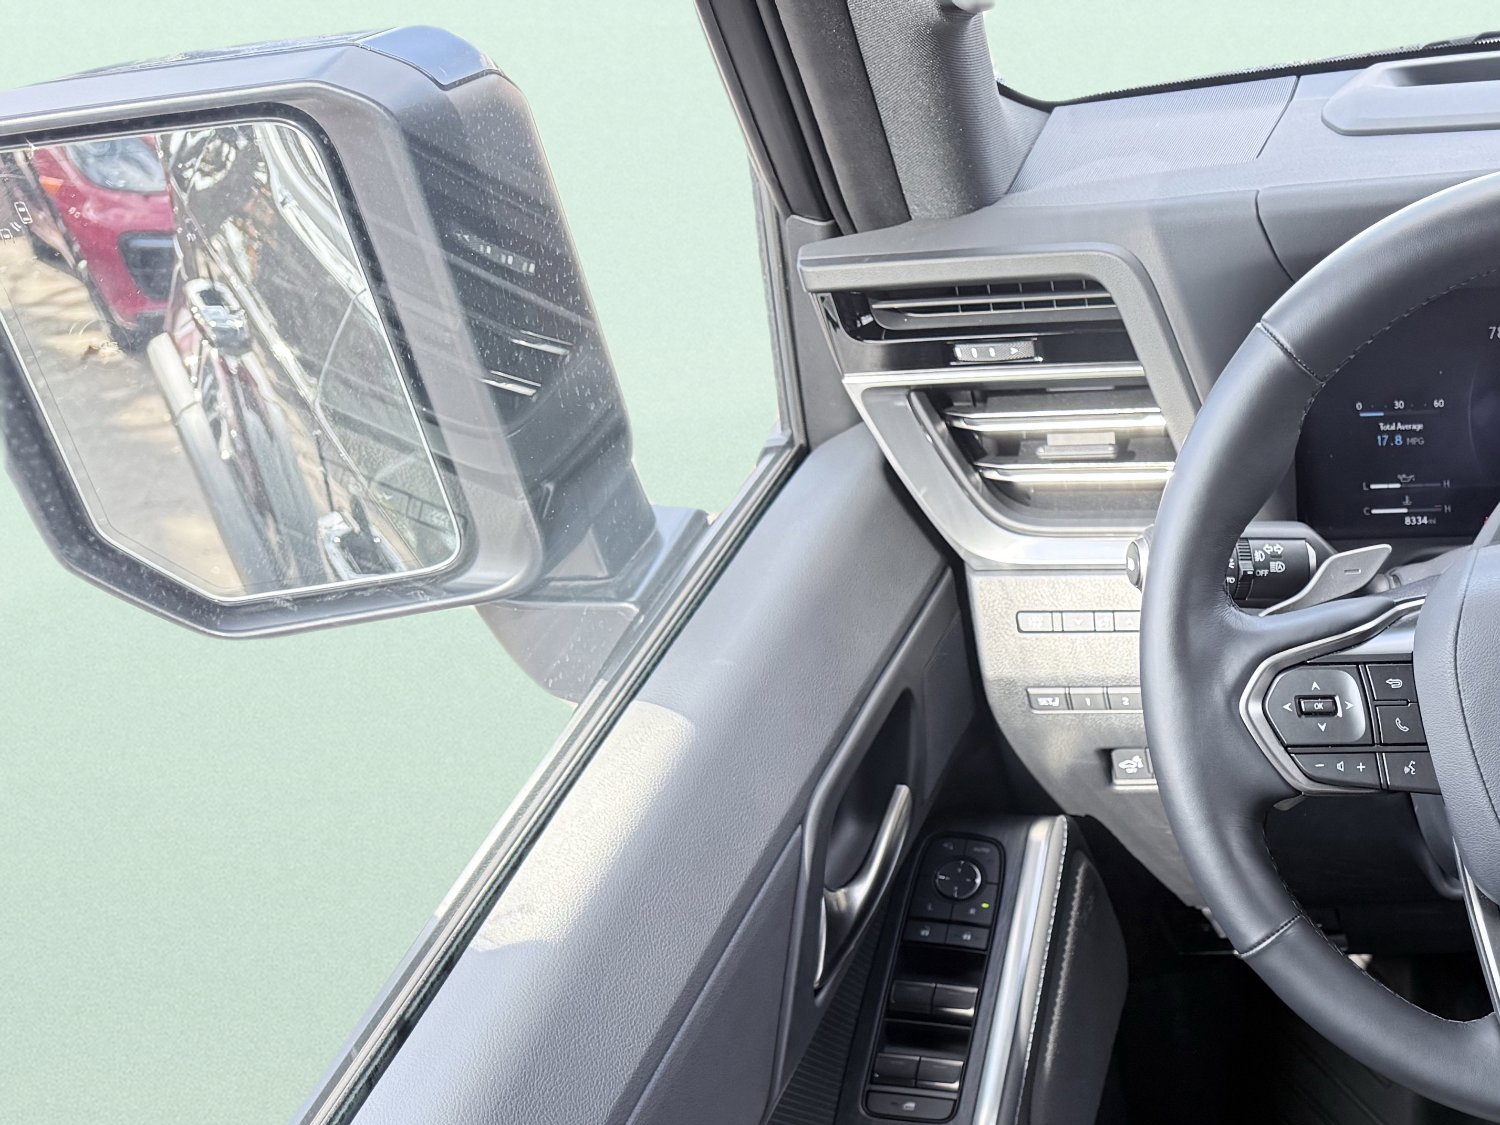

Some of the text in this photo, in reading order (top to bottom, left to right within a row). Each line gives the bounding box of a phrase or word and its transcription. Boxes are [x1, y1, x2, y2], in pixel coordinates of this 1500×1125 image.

[1356, 398, 1445, 411] 0 30 60
[1379, 422, 1424, 432] Total Average
[1377, 434, 1403, 447] 17.8
[1363, 481, 1369, 491] L
[1444, 504, 1451, 513] H
[1404, 515, 1428, 526] 8334
[1255, 569, 1270, 577] OFF
[1121, 696, 1130, 706] 2
[1314, 702, 1324, 710] OK
